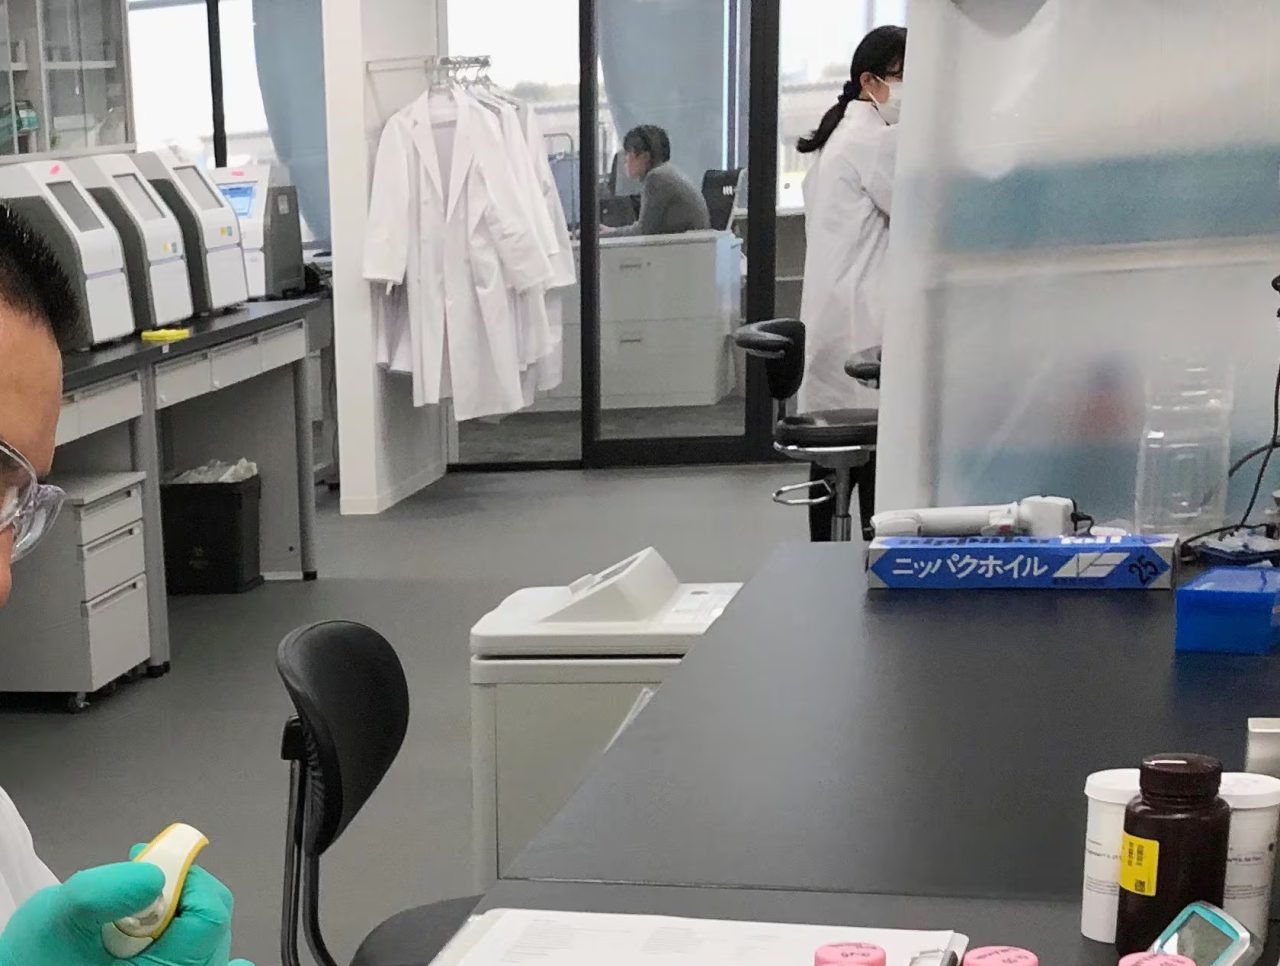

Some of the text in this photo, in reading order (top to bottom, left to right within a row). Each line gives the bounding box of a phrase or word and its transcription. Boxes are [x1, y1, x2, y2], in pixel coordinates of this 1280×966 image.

[892, 553, 1050, 578] ニッパクホイル
[1128, 555, 1162, 586] 25
